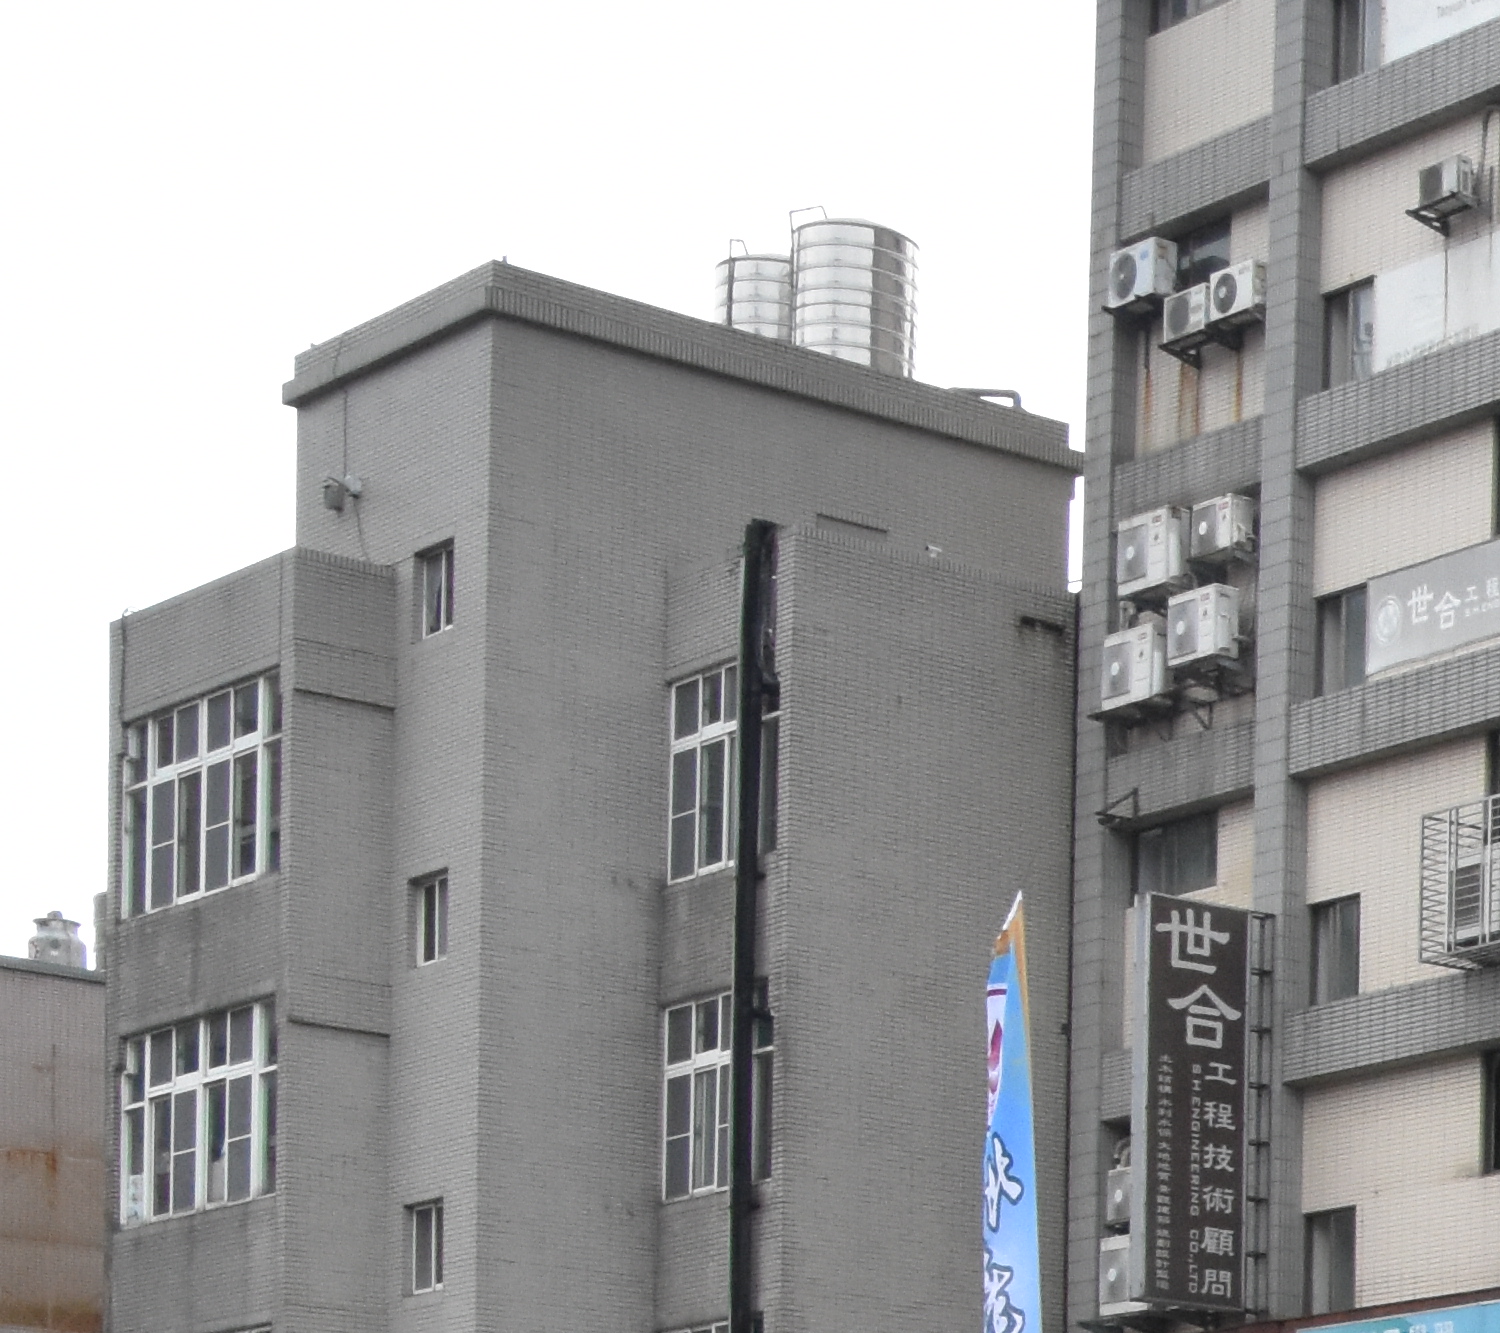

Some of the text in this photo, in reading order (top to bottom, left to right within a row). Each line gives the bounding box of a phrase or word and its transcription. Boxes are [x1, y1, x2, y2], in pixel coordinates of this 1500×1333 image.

[1407, 584, 1462, 630] 世合
[1155, 908, 1242, 1299] 世合 工程技術顧問
